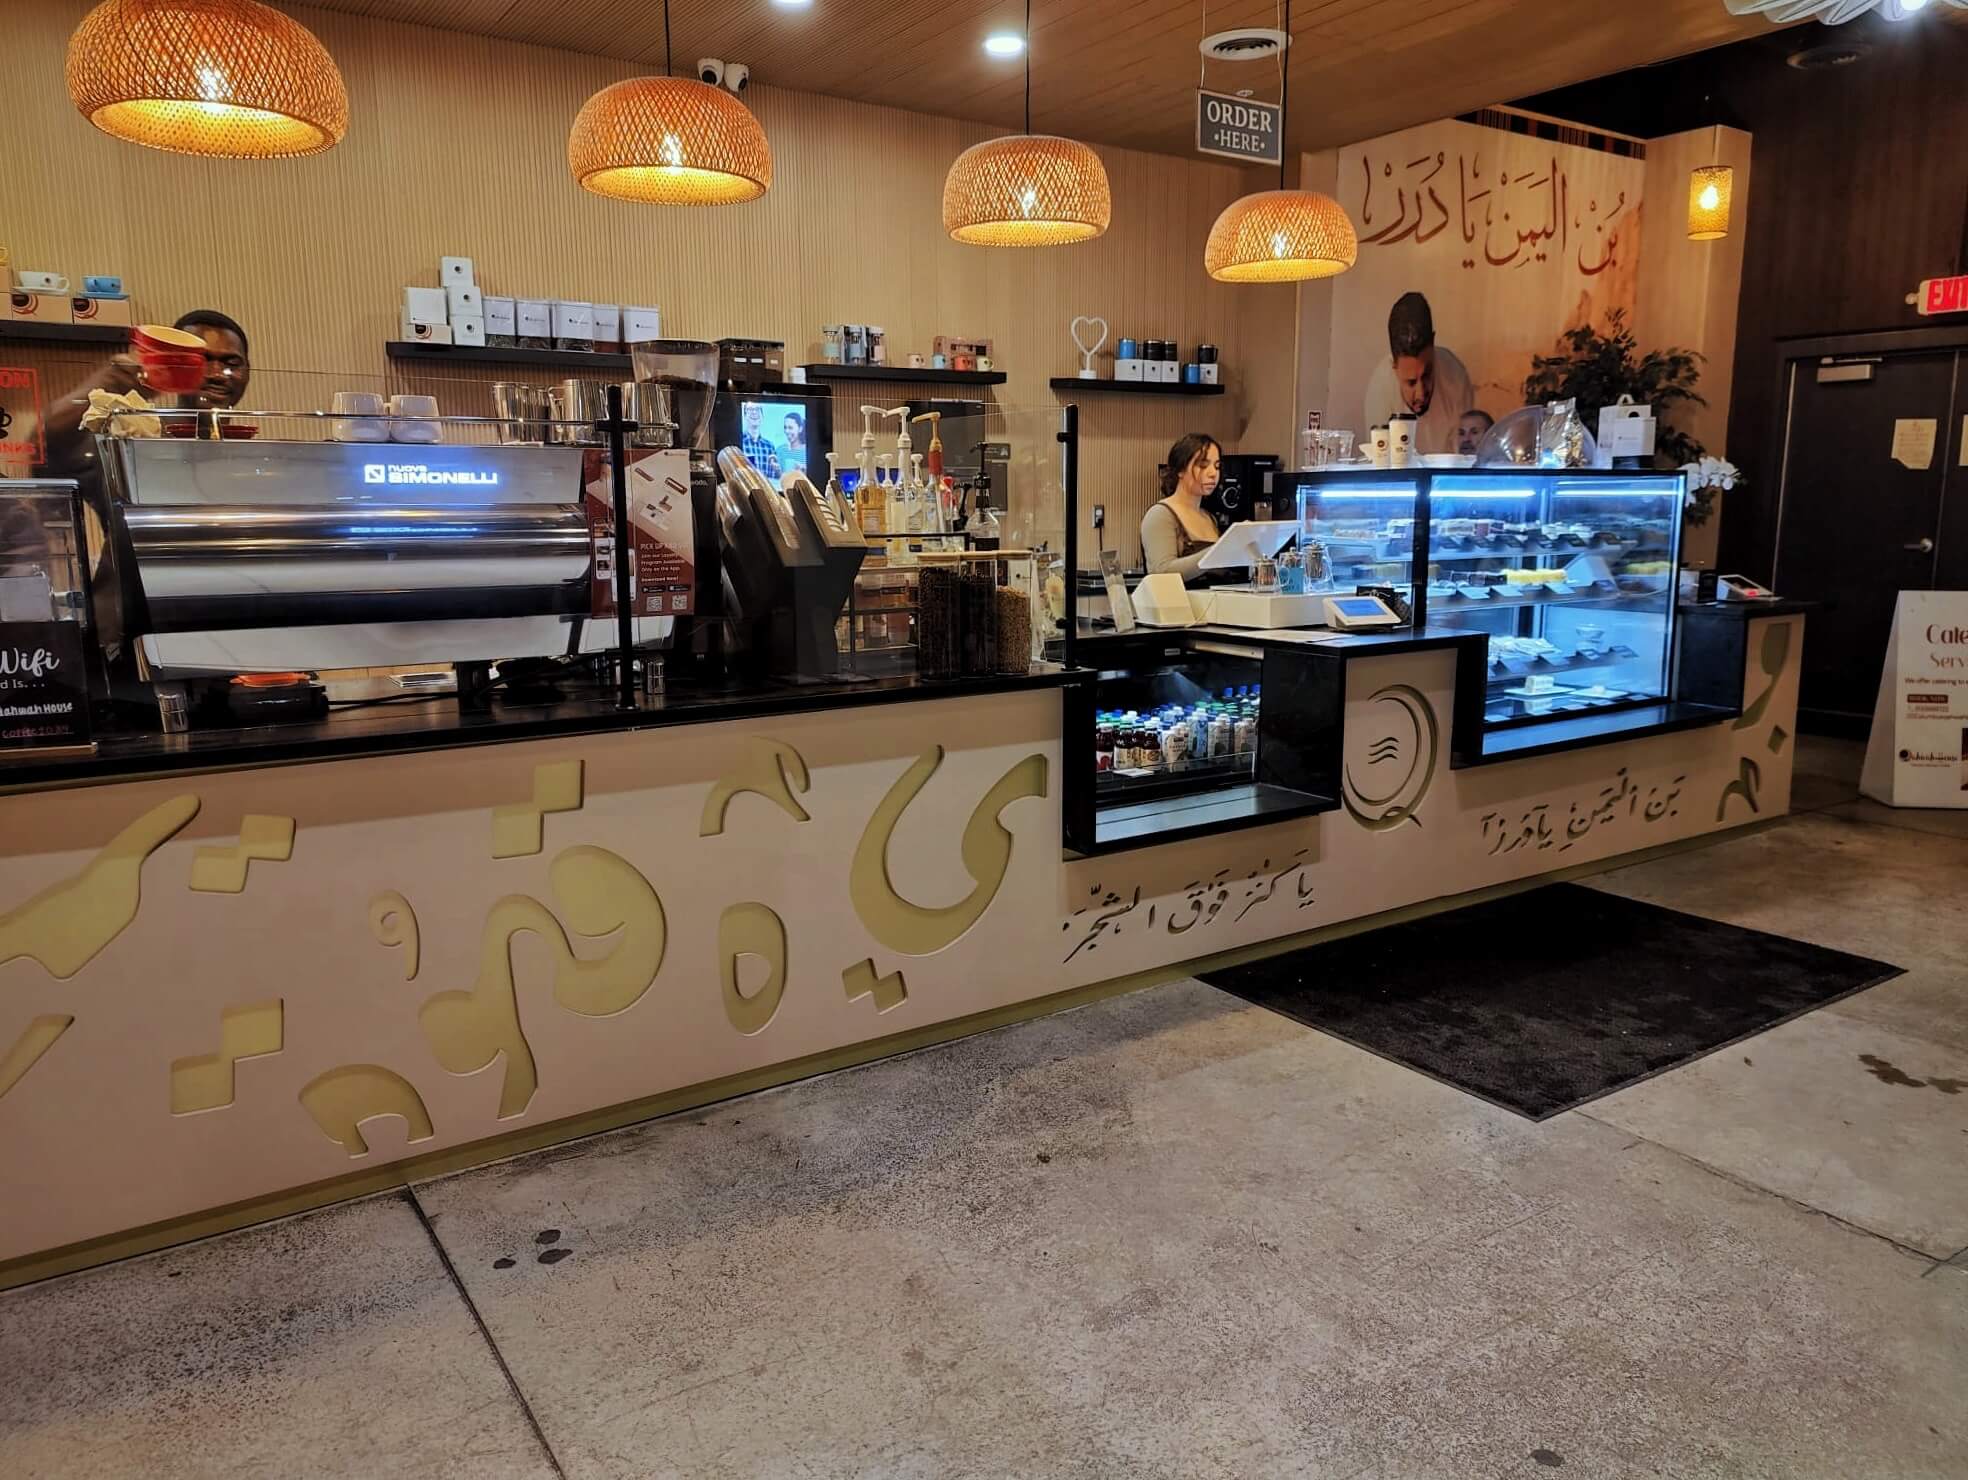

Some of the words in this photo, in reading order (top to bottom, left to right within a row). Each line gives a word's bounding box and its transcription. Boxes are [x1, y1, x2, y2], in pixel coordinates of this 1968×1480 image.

[1207, 101, 1272, 133] ORDER
[388, 472, 498, 484] SIMONELLI
[0, 647, 60, 677] Wifi
